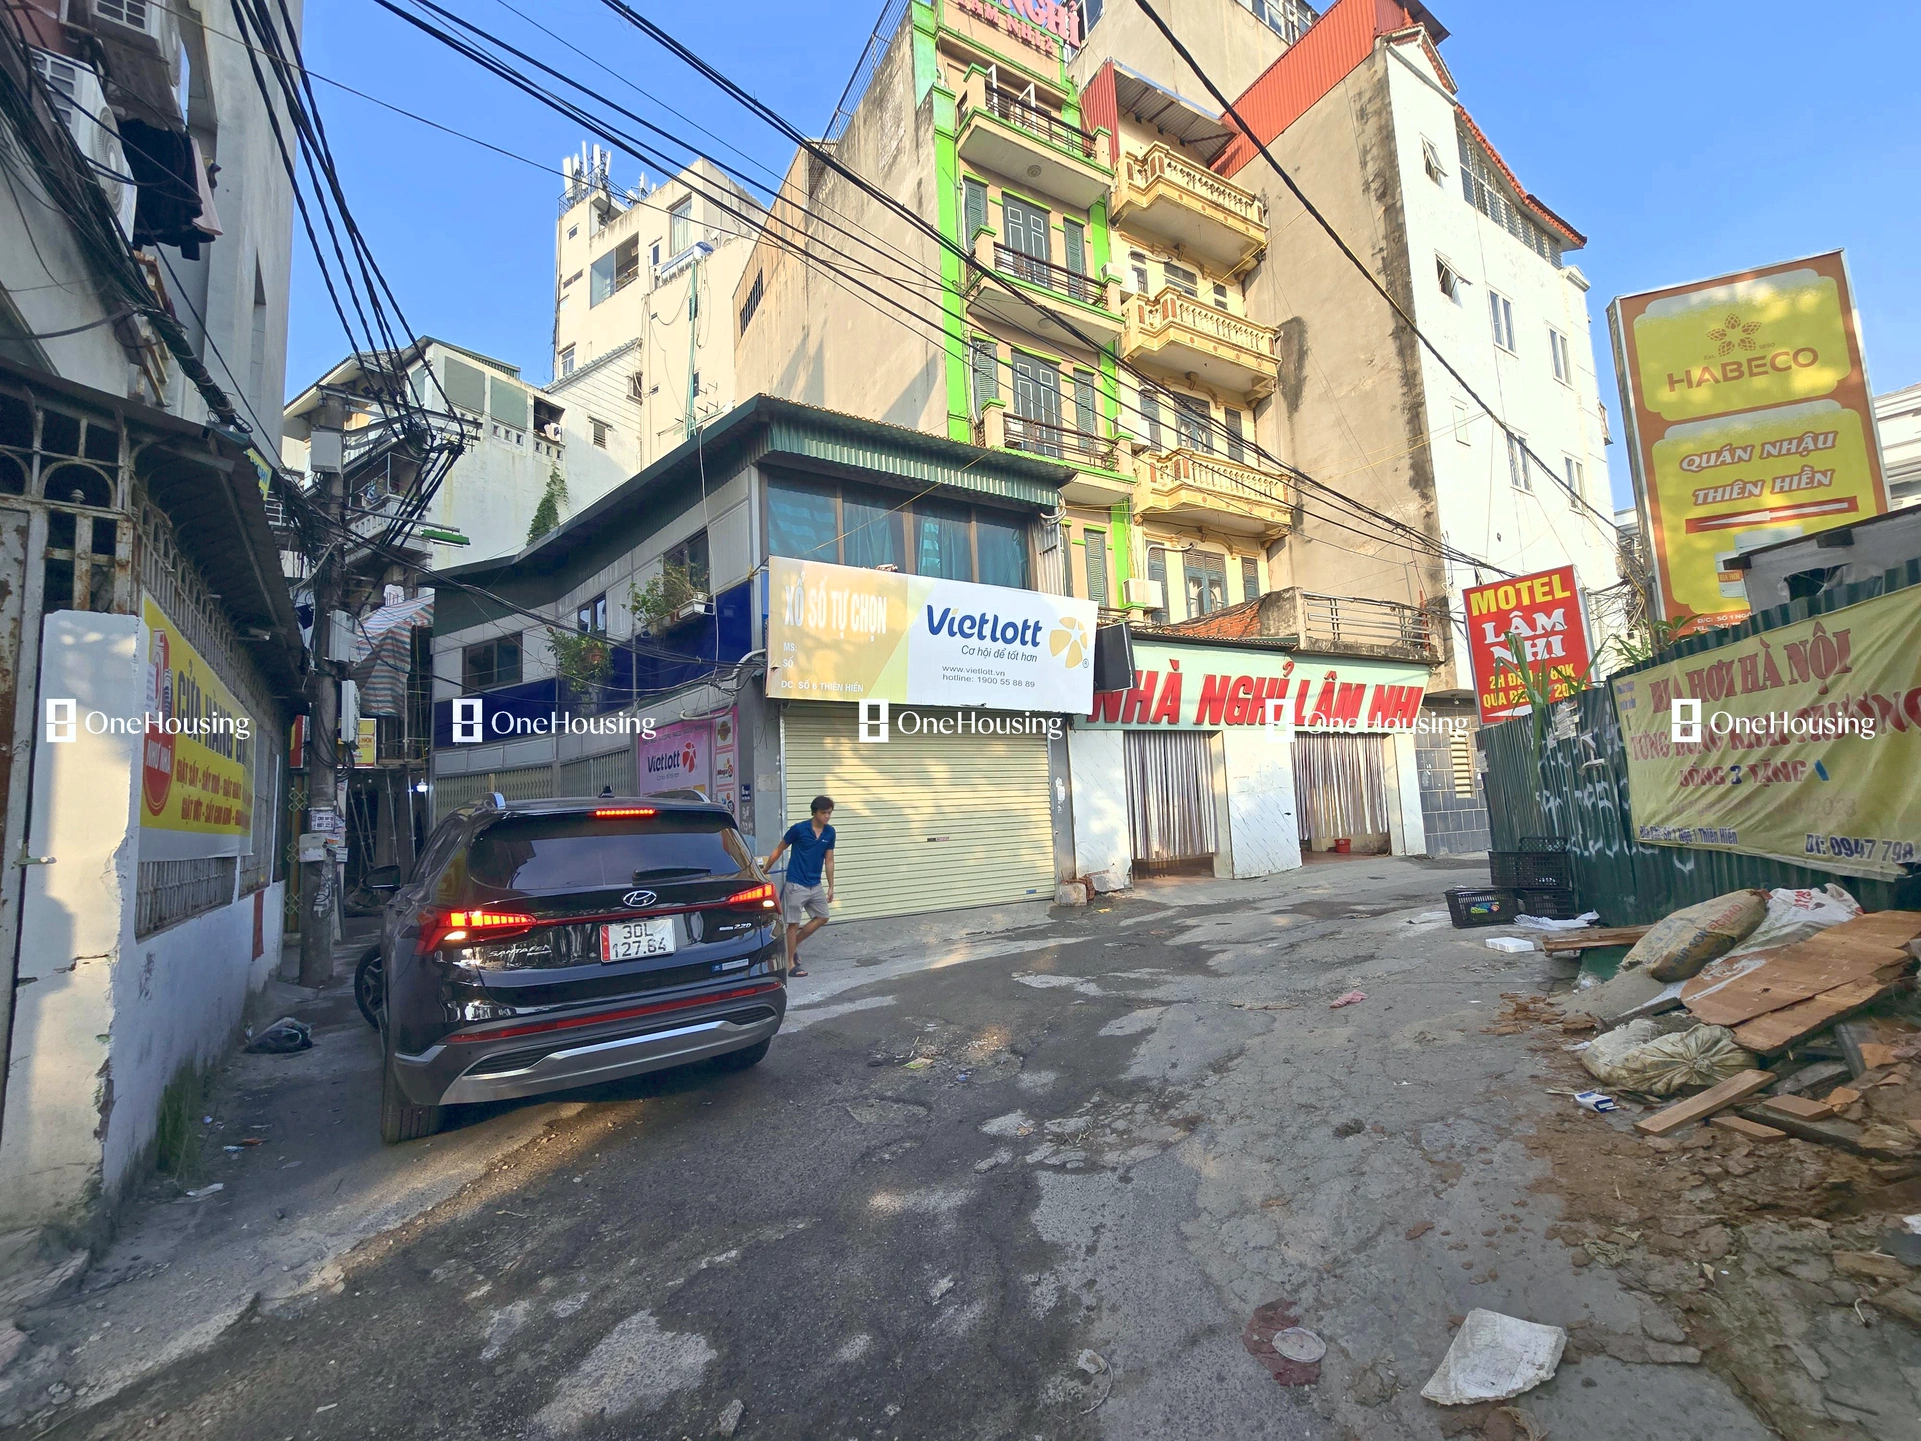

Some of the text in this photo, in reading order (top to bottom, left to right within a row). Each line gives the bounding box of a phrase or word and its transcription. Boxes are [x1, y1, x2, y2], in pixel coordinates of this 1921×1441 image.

[1667, 346, 1819, 393] HABECO
[1680, 432, 1837, 471] QUÁN NHẬU
[1694, 480, 1764, 505] THIÊN
[784, 570, 888, 642] XỔ SỐ TỰ CHỌN
[1469, 574, 1571, 617] MOTEL
[926, 604, 1043, 648] Vietlott
[1481, 608, 1568, 644] LÂM
[961, 644, 1038, 663] Cơ hội để tốt hơn
[1490, 634, 1567, 668] NHI
[942, 665, 1006, 678] www.vietlott.vn
[1649, 674, 1688, 713] BIA
[1738, 636, 1785, 694] HÀ
[1783, 621, 1853, 695] NỘI
[812, 682, 818, 690] 6
[819, 681, 843, 692] THIÊN
[942, 673, 975, 684] hotline:
[977, 676, 998, 685] 1900
[1012, 680, 1023, 688] 88
[1087, 658, 1424, 729] NHÀ NGHỈ LÂM NHI
[1483, 692, 1508, 709] QUA
[647, 750, 681, 773] Vietlott
[1698, 828, 1719, 844] Thiên
[1829, 836, 1877, 859] 0947
[623, 923, 654, 940] 30L
[612, 937, 667, 959] 127.64
